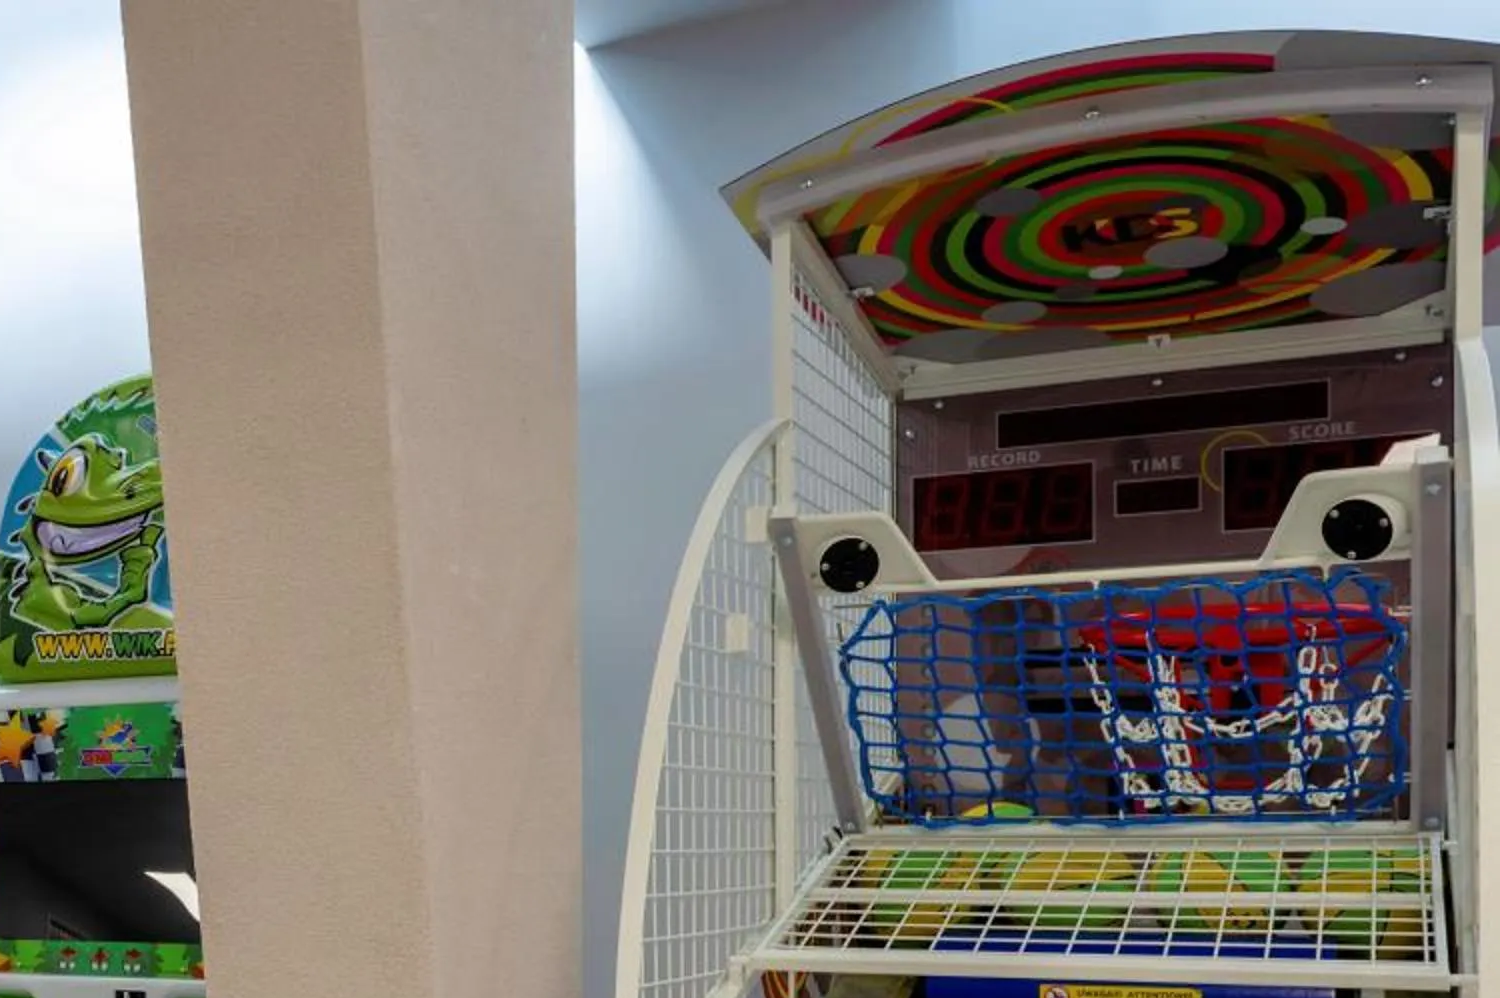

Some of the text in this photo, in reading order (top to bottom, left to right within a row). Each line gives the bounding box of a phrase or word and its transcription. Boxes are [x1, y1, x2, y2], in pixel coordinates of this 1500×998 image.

[1289, 421, 1356, 440] SCORE
[967, 450, 1041, 469] RECORD
[1131, 455, 1182, 474] TIME
